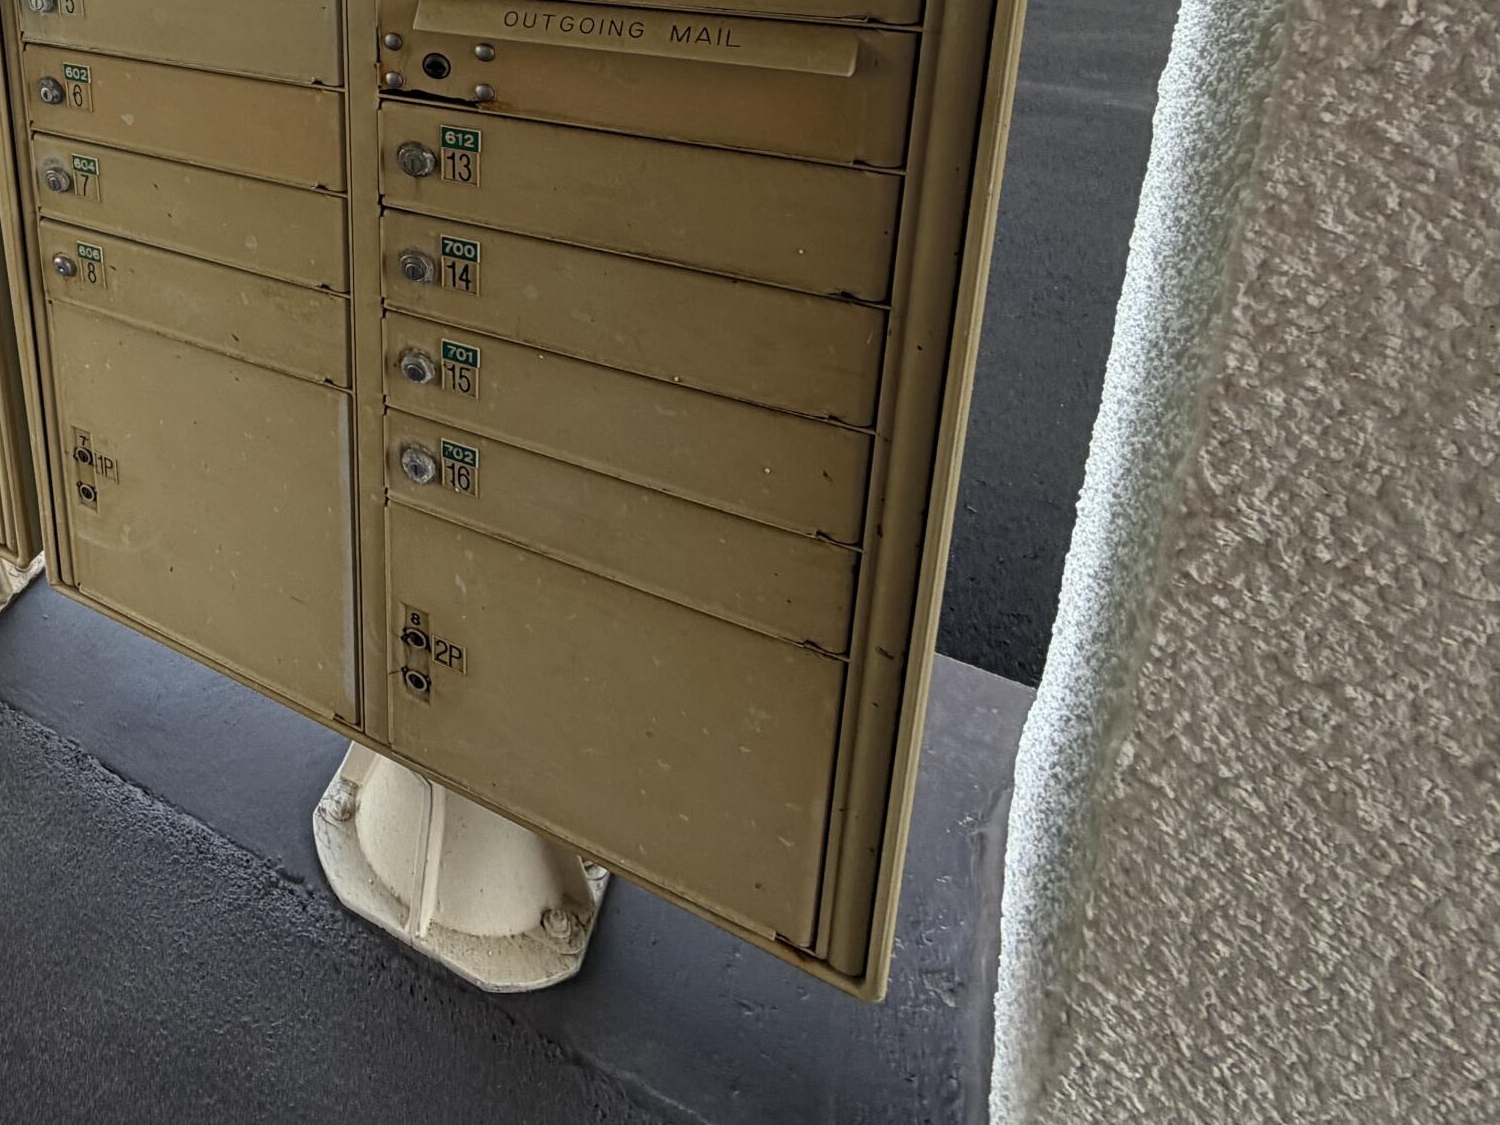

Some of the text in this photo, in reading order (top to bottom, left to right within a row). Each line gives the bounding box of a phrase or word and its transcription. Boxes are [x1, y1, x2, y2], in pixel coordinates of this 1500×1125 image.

[503, 10, 742, 49] OUTGOING MAIL
[65, 67, 87, 81] 602
[72, 84, 83, 108] 6
[444, 130, 476, 148] 612
[73, 159, 96, 171] 604
[446, 151, 472, 182] 13
[80, 173, 89, 197] 7
[78, 246, 101, 260] 606
[443, 239, 476, 259] 700
[87, 261, 97, 284] 8
[446, 260, 472, 291] 14
[446, 345, 474, 363] 701
[446, 363, 471, 393] 15
[443, 443, 474, 464] 702
[98, 454, 114, 479] 1P
[446, 463, 470, 492] 16
[410, 612, 421, 626] 8
[434, 638, 462, 669] 2P
